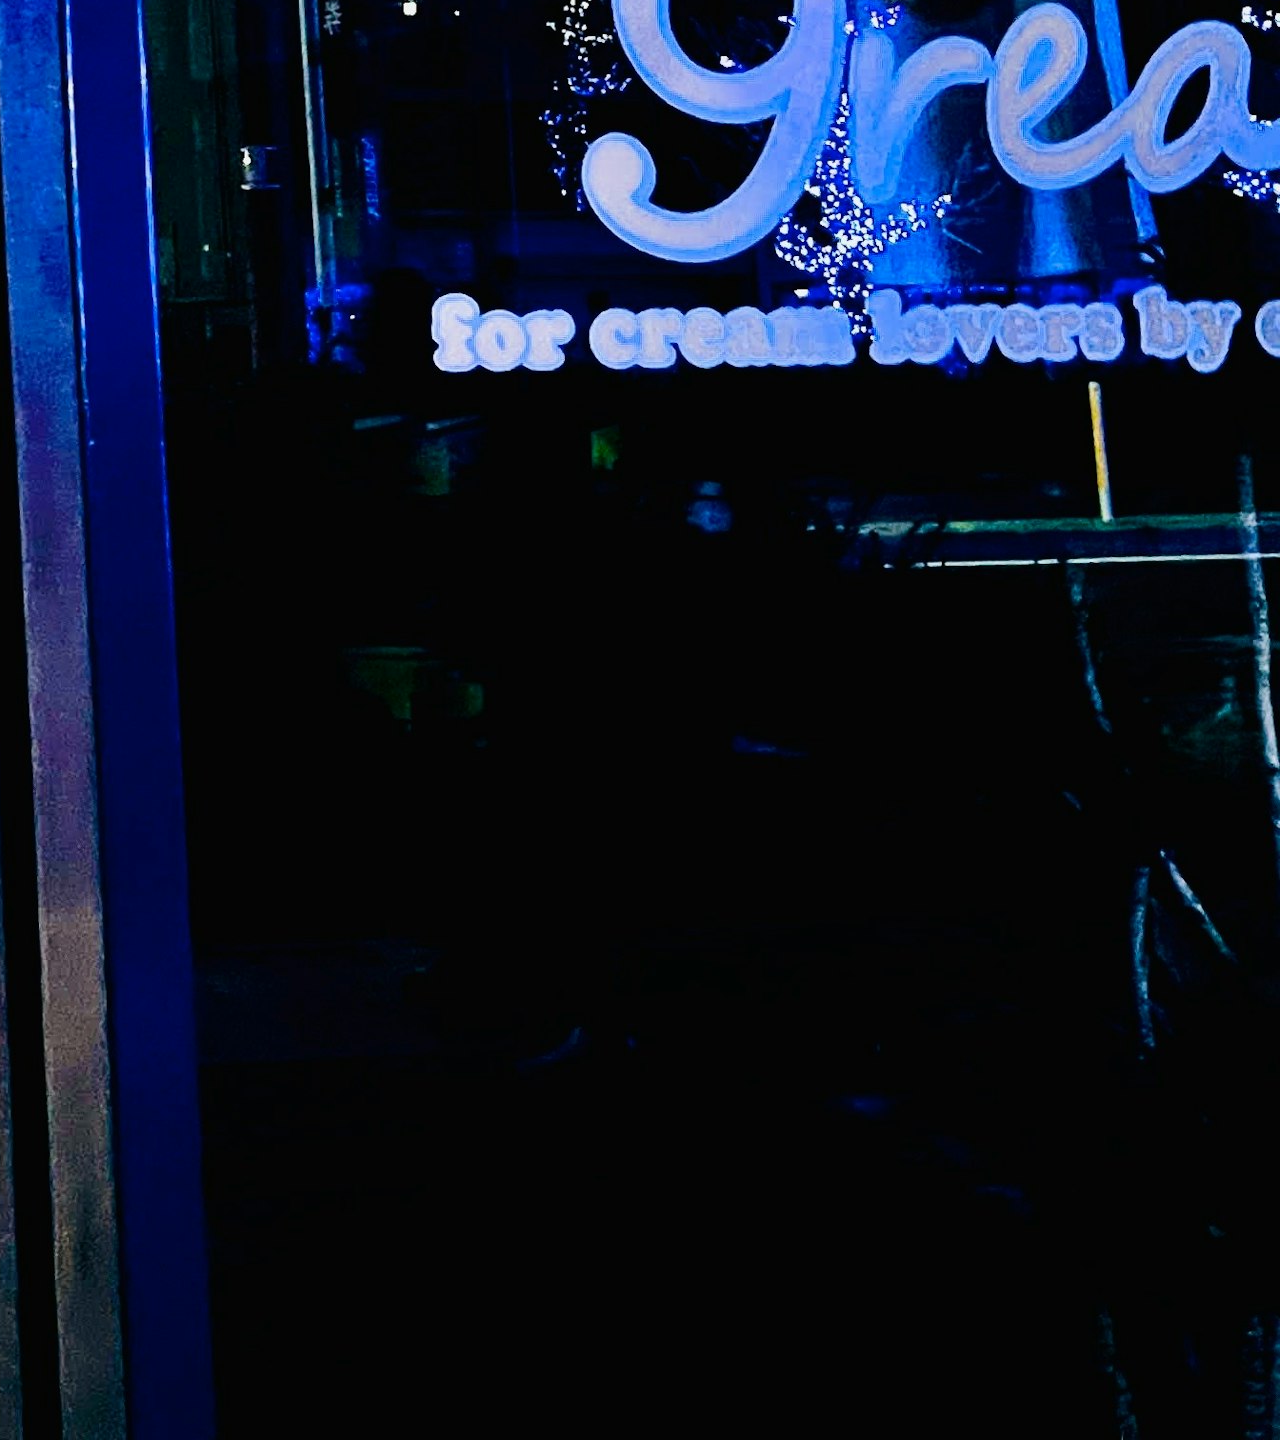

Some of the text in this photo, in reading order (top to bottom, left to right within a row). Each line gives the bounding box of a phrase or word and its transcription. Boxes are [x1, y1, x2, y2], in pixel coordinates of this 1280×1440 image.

[431, 292, 575, 372] for
[589, 306, 856, 366] cream
[868, 288, 1125, 365] lovers
[1133, 284, 1242, 374] by
